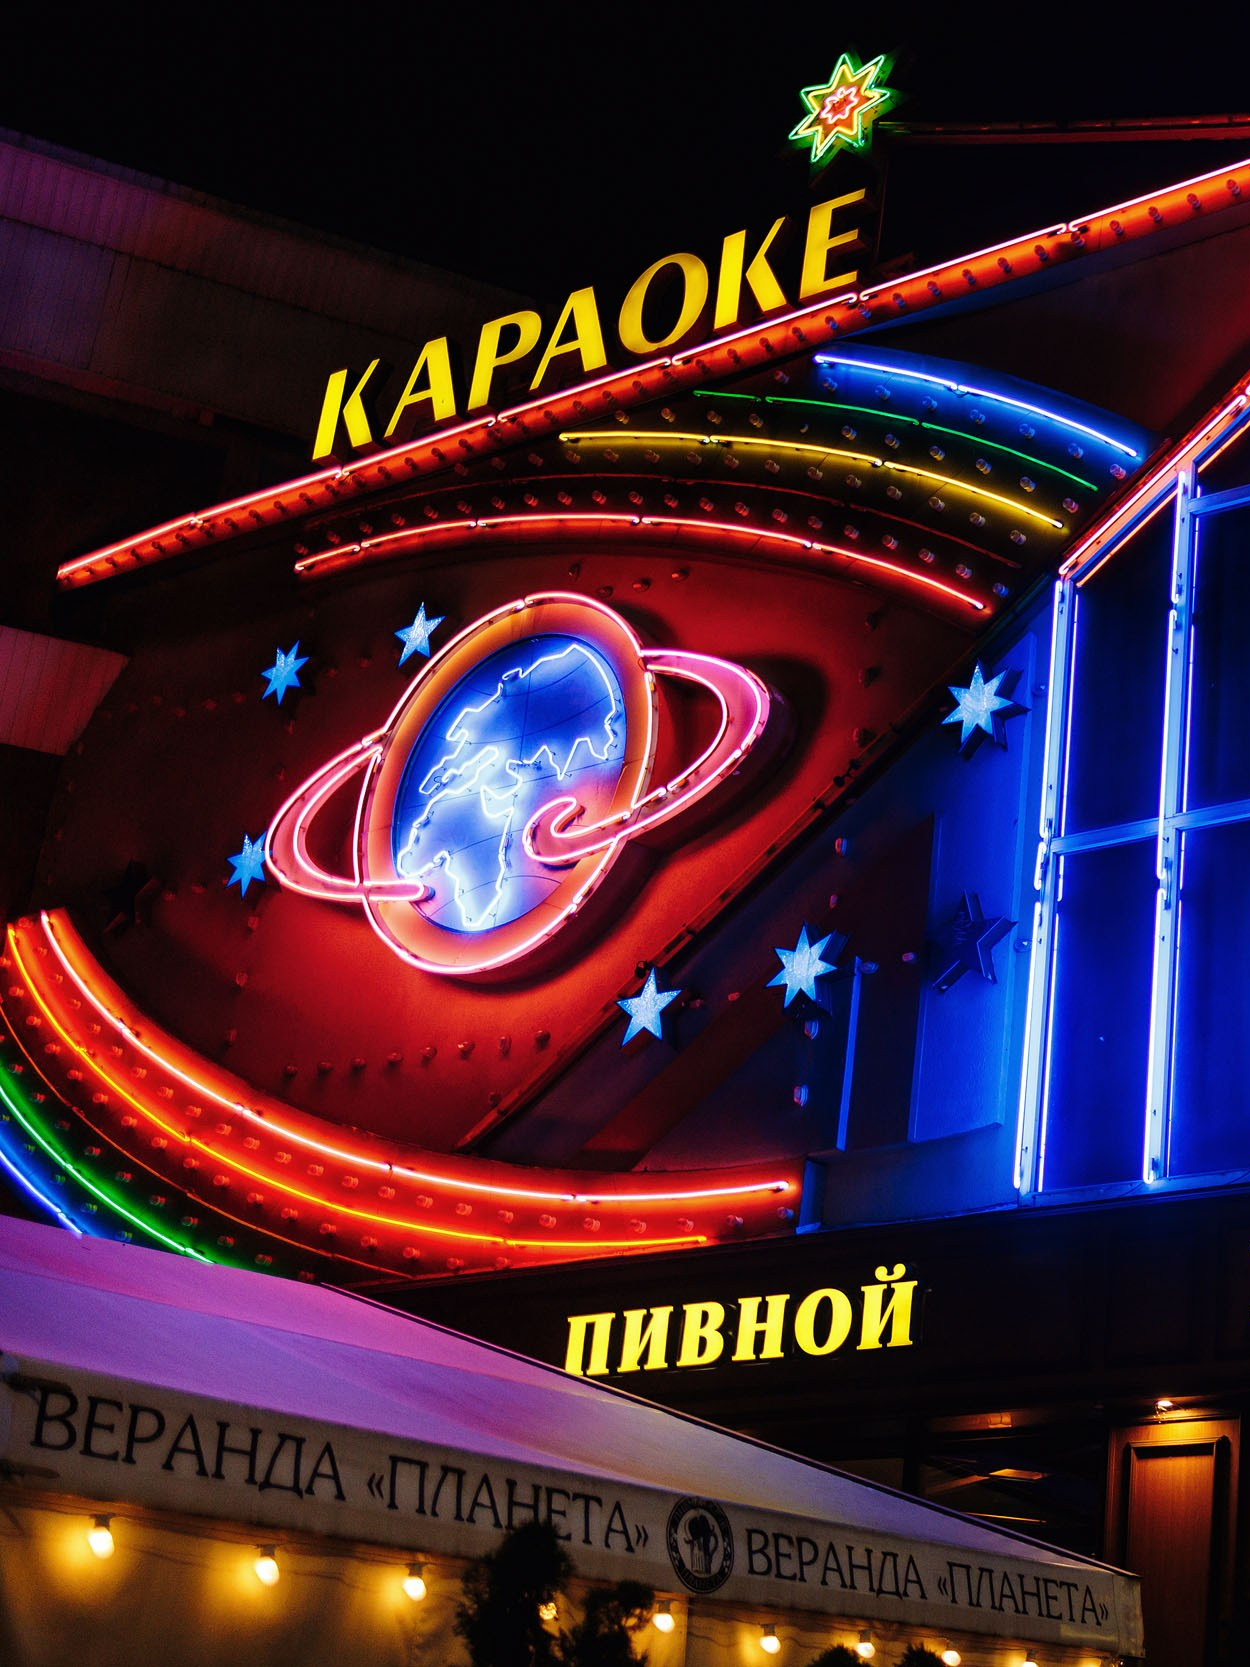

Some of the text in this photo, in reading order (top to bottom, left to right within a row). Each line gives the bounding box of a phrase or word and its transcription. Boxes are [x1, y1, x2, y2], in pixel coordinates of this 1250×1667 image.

[312, 188, 866, 462] КАРАОКЕ
[565, 1263, 918, 1377] ПИВНОЙ
[30, 1387, 1109, 1626] ВЕРАНДА «ПЛАНЕТА» ВЕРАНДА «ПЛАНЕТА»
